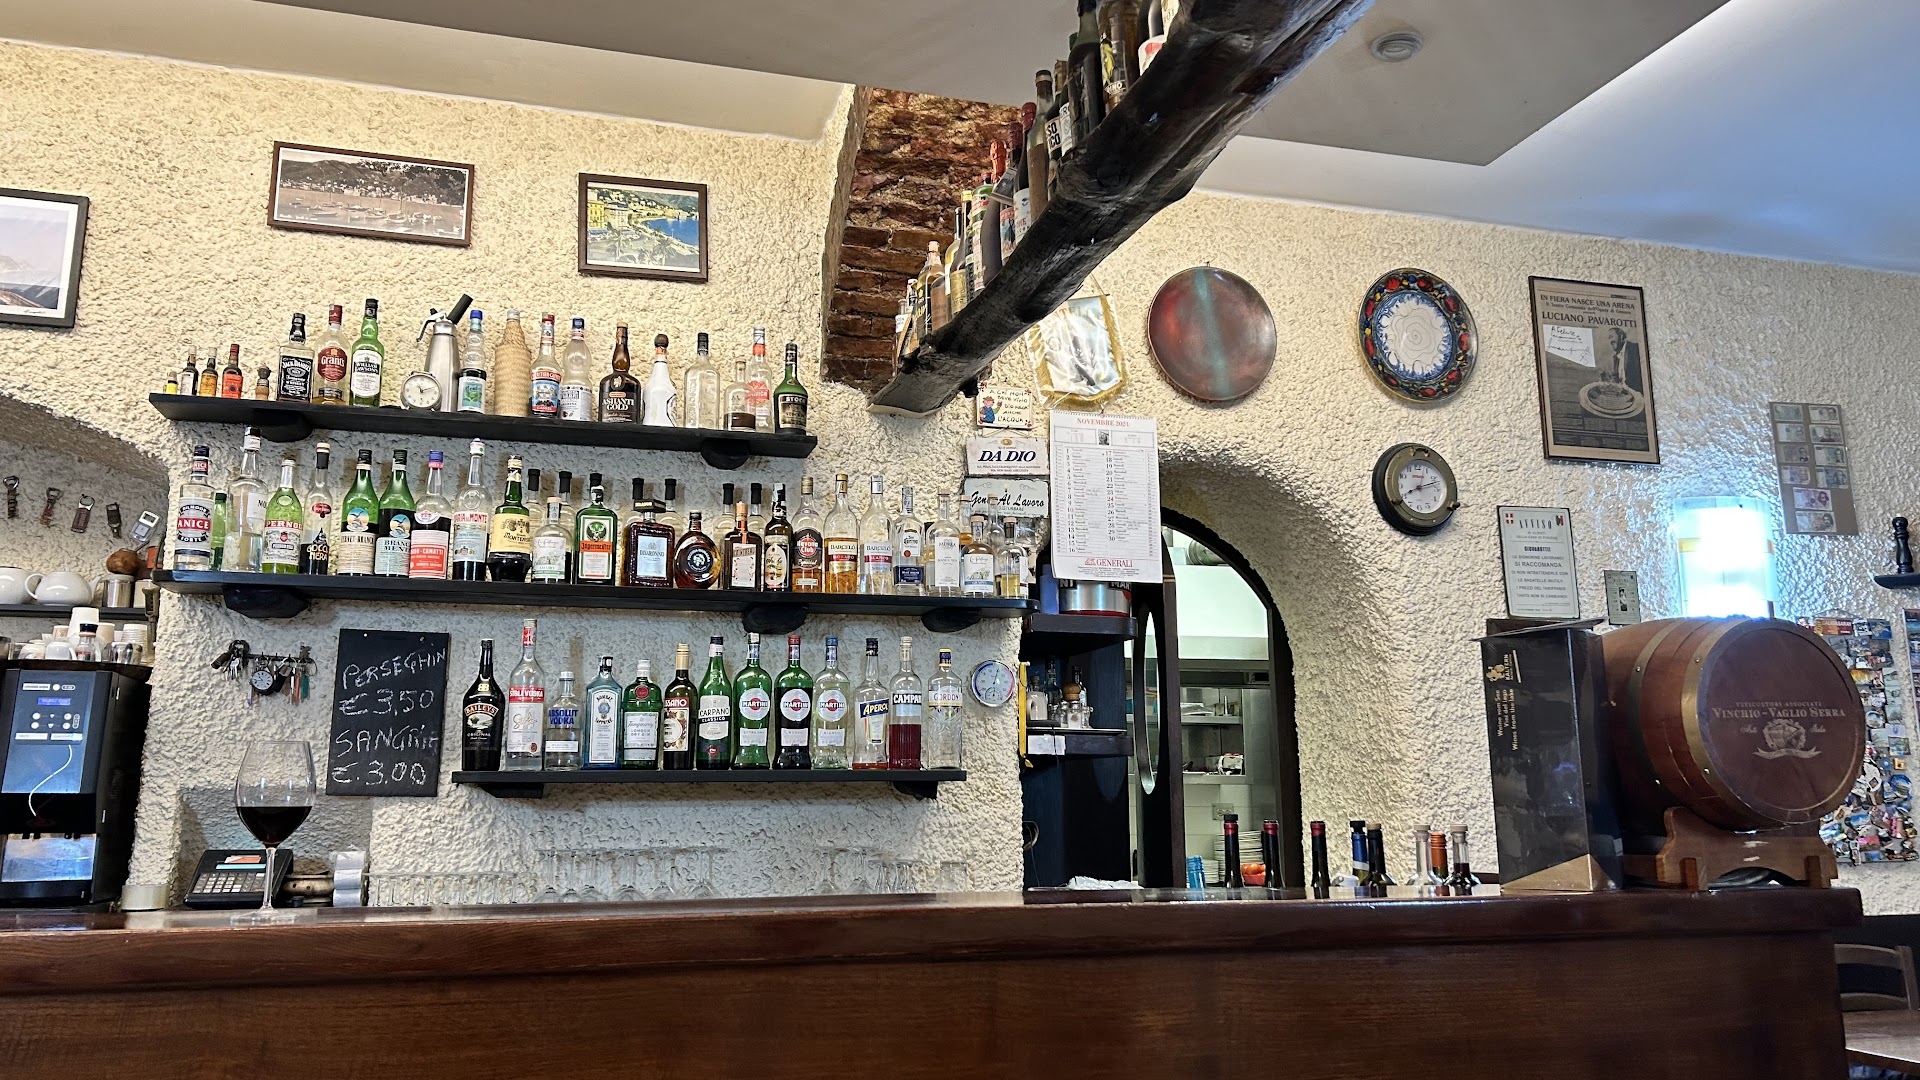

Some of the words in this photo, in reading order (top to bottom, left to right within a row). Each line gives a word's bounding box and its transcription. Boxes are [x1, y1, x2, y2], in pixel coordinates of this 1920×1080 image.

[1550, 296, 1569, 304] FIERA
[1542, 311, 1584, 323] LUCIANO
[1588, 317, 1637, 328] PAVAROTTI
[1077, 418, 1114, 426] NOVEMBRE
[978, 450, 1002, 462] DA
[1004, 451, 1036, 462] DIO
[1014, 494, 1044, 507] Lavoro
[178, 518, 209, 530] ANICE
[1519, 519, 1552, 529] AVVISO
[309, 552, 328, 560] NERA
[1097, 559, 1133, 568] GENERALI
[342, 648, 446, 690] PERSEGHIN
[339, 692, 368, 715] €
[894, 694, 921, 704] CAMPA
[465, 704, 496, 714] BAILEYS
[700, 708, 730, 717] CARPANO
[863, 703, 888, 716] APEROL
[1810, 707, 1846, 717] SERRA
